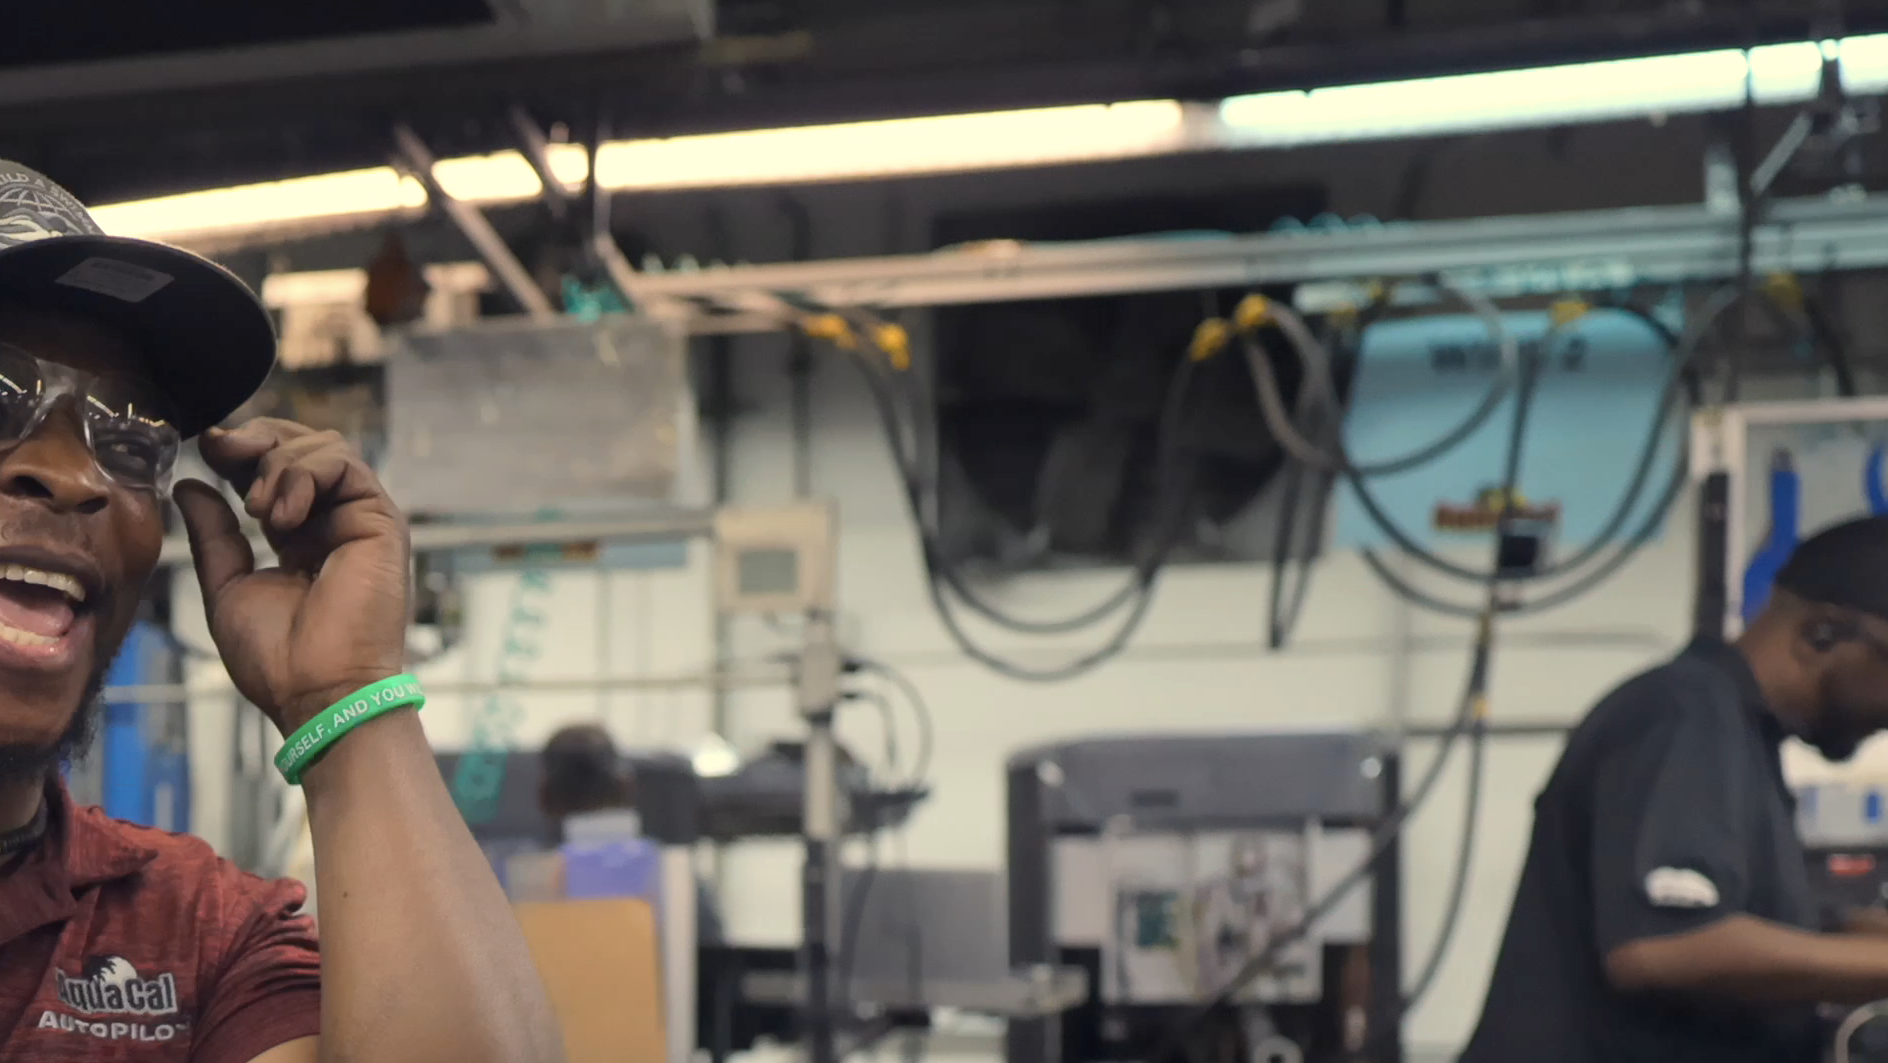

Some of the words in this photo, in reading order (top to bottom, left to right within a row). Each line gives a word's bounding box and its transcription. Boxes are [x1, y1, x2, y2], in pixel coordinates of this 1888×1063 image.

[34, 179, 46, 191] A
[279, 723, 332, 772] OURSELF,
[333, 699, 368, 728] AND
[371, 684, 405, 706] YOU
